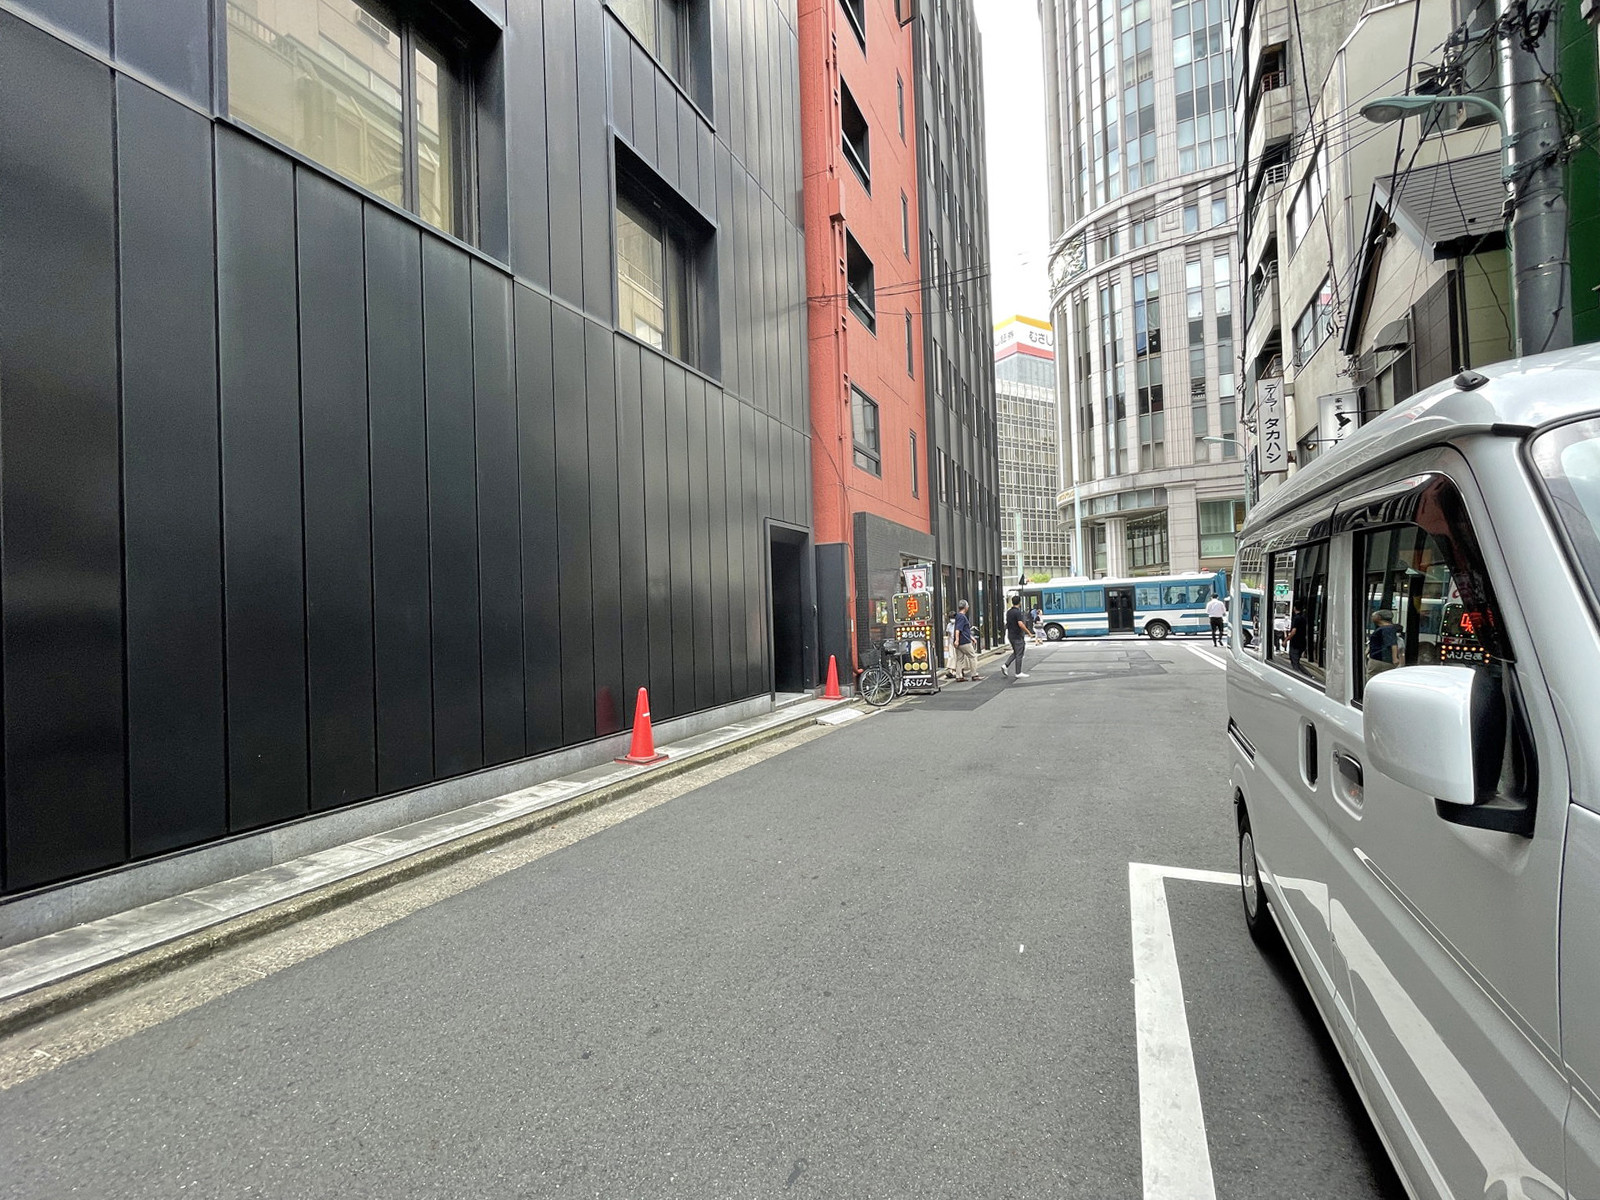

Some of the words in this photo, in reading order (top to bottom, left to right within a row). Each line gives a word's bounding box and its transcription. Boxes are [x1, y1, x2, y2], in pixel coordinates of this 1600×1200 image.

[1028, 330, 1054, 347] むさし
[1264, 418, 1281, 464] タカハシ
[901, 631, 926, 639] あらじん
[903, 678, 933, 688] あらじん
